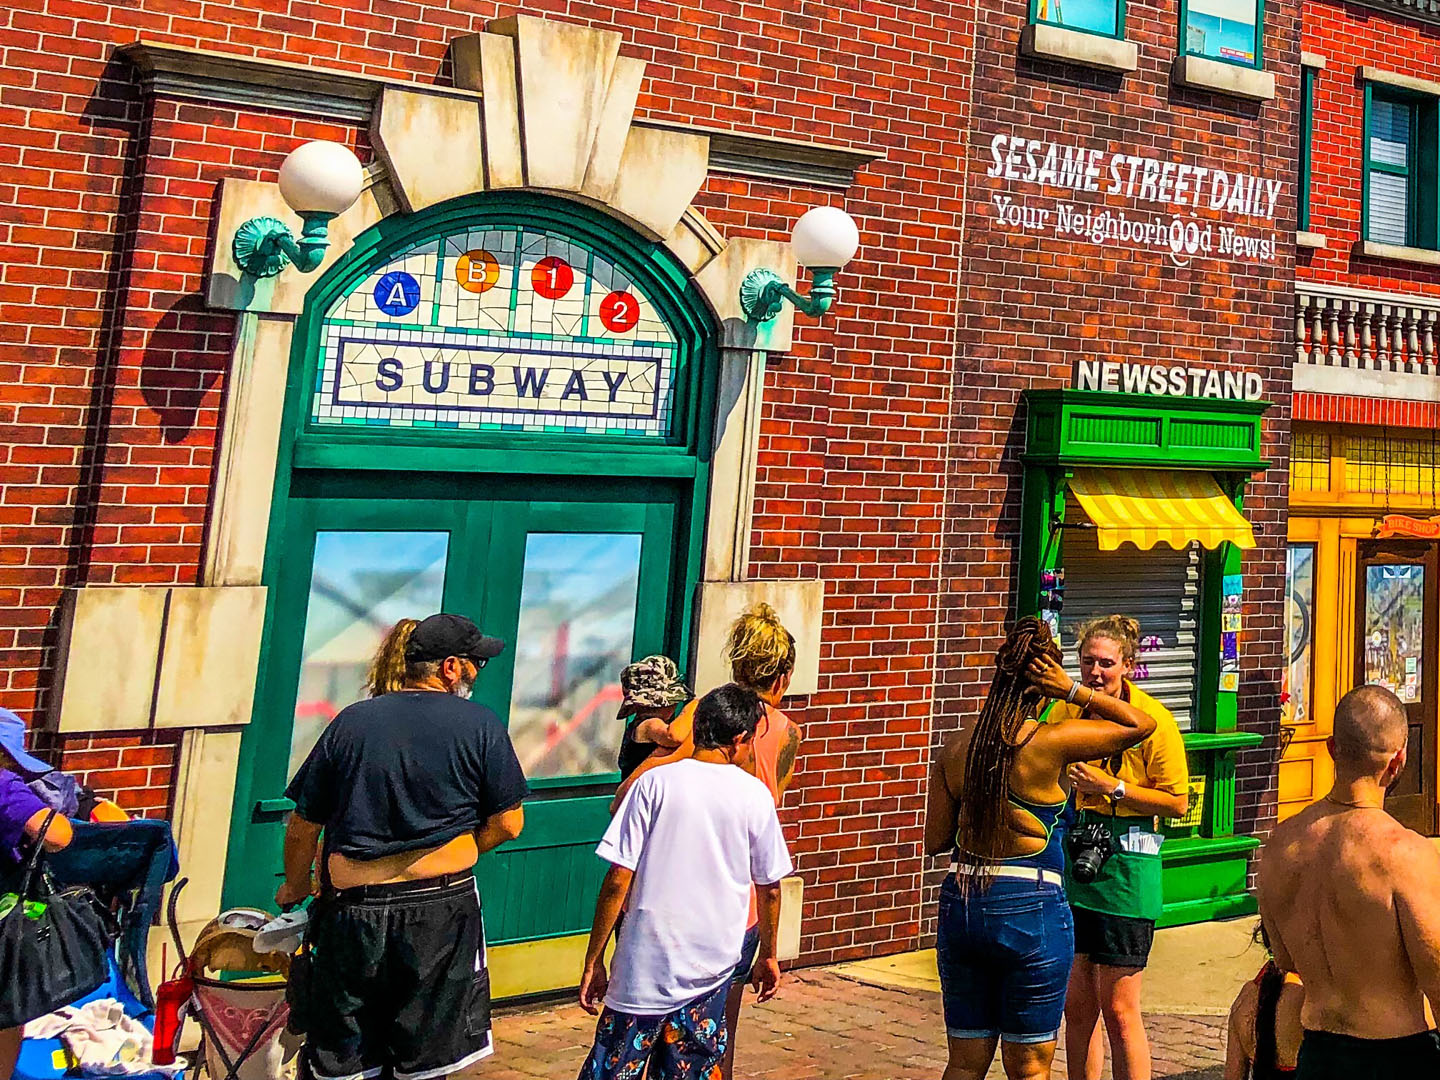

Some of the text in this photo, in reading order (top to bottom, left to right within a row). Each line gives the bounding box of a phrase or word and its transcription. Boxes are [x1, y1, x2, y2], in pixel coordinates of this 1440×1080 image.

[987, 134, 1282, 220] SESAME STREET DAILY
[993, 194, 1049, 232] Your
[1218, 226, 1276, 260] News!
[375, 358, 629, 403] SUBWAY
[1077, 360, 1263, 401] NEWSSTAND
[1388, 519, 1437, 534] BIKE SHOP
